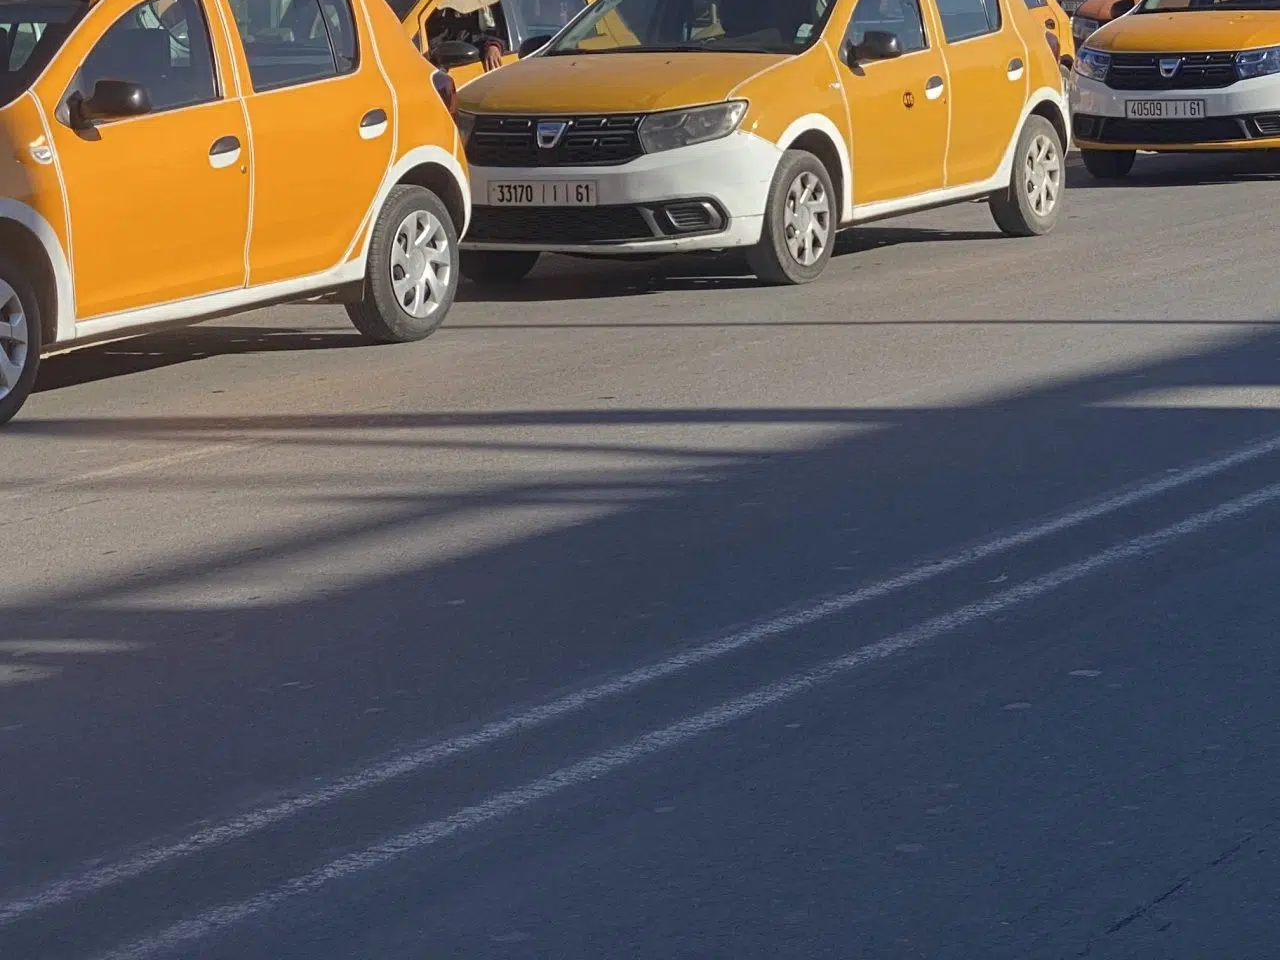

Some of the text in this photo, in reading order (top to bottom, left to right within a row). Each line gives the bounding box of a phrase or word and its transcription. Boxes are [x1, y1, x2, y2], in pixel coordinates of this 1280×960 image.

[1131, 102, 1162, 116] 40509
[1189, 101, 1201, 116] 61
[497, 184, 533, 202] 33170
[575, 184, 590, 202] 61
